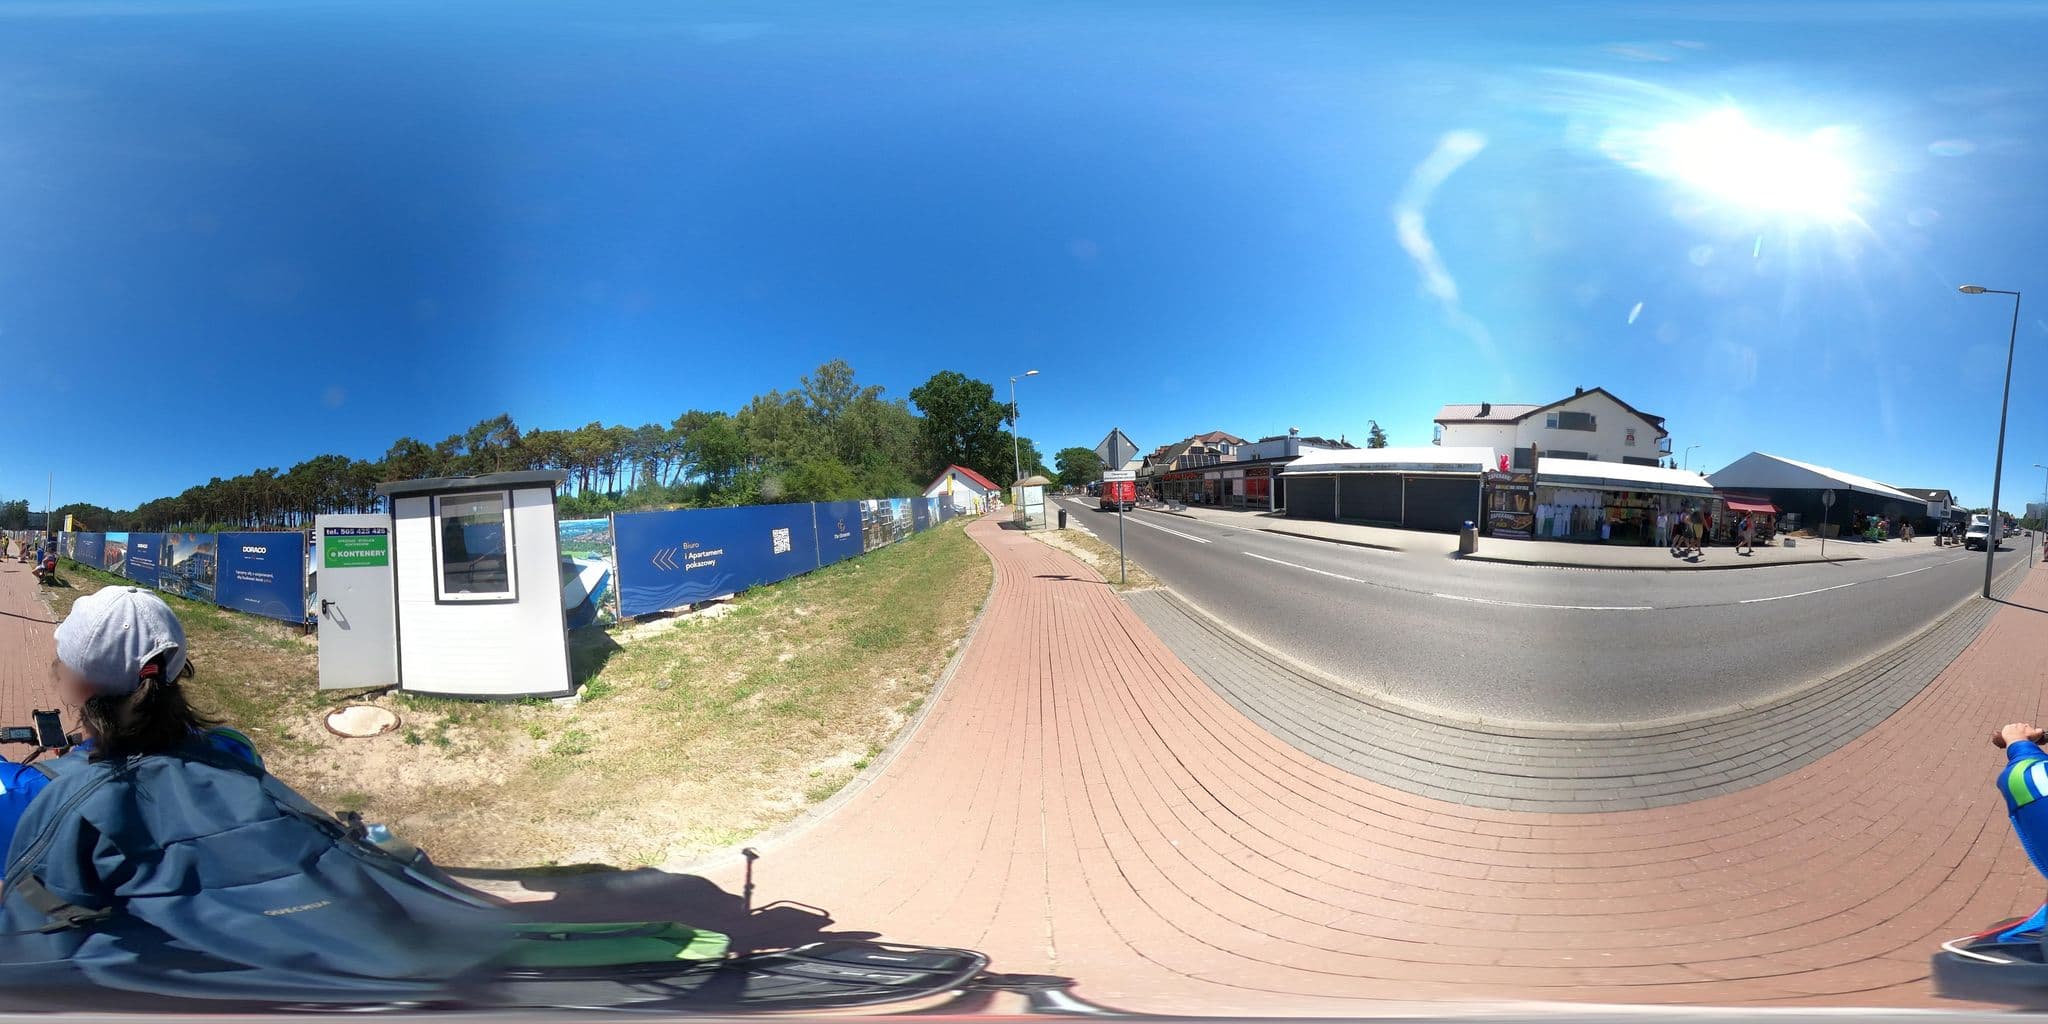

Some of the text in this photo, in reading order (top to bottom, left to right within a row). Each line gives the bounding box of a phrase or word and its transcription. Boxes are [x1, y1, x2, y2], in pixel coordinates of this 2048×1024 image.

[242, 546, 267, 554] DORACO
[683, 542, 700, 550] Biuro
[337, 549, 386, 558] KONTENERY
[688, 548, 723, 561] Apartament
[685, 558, 716, 572] pokazowy
